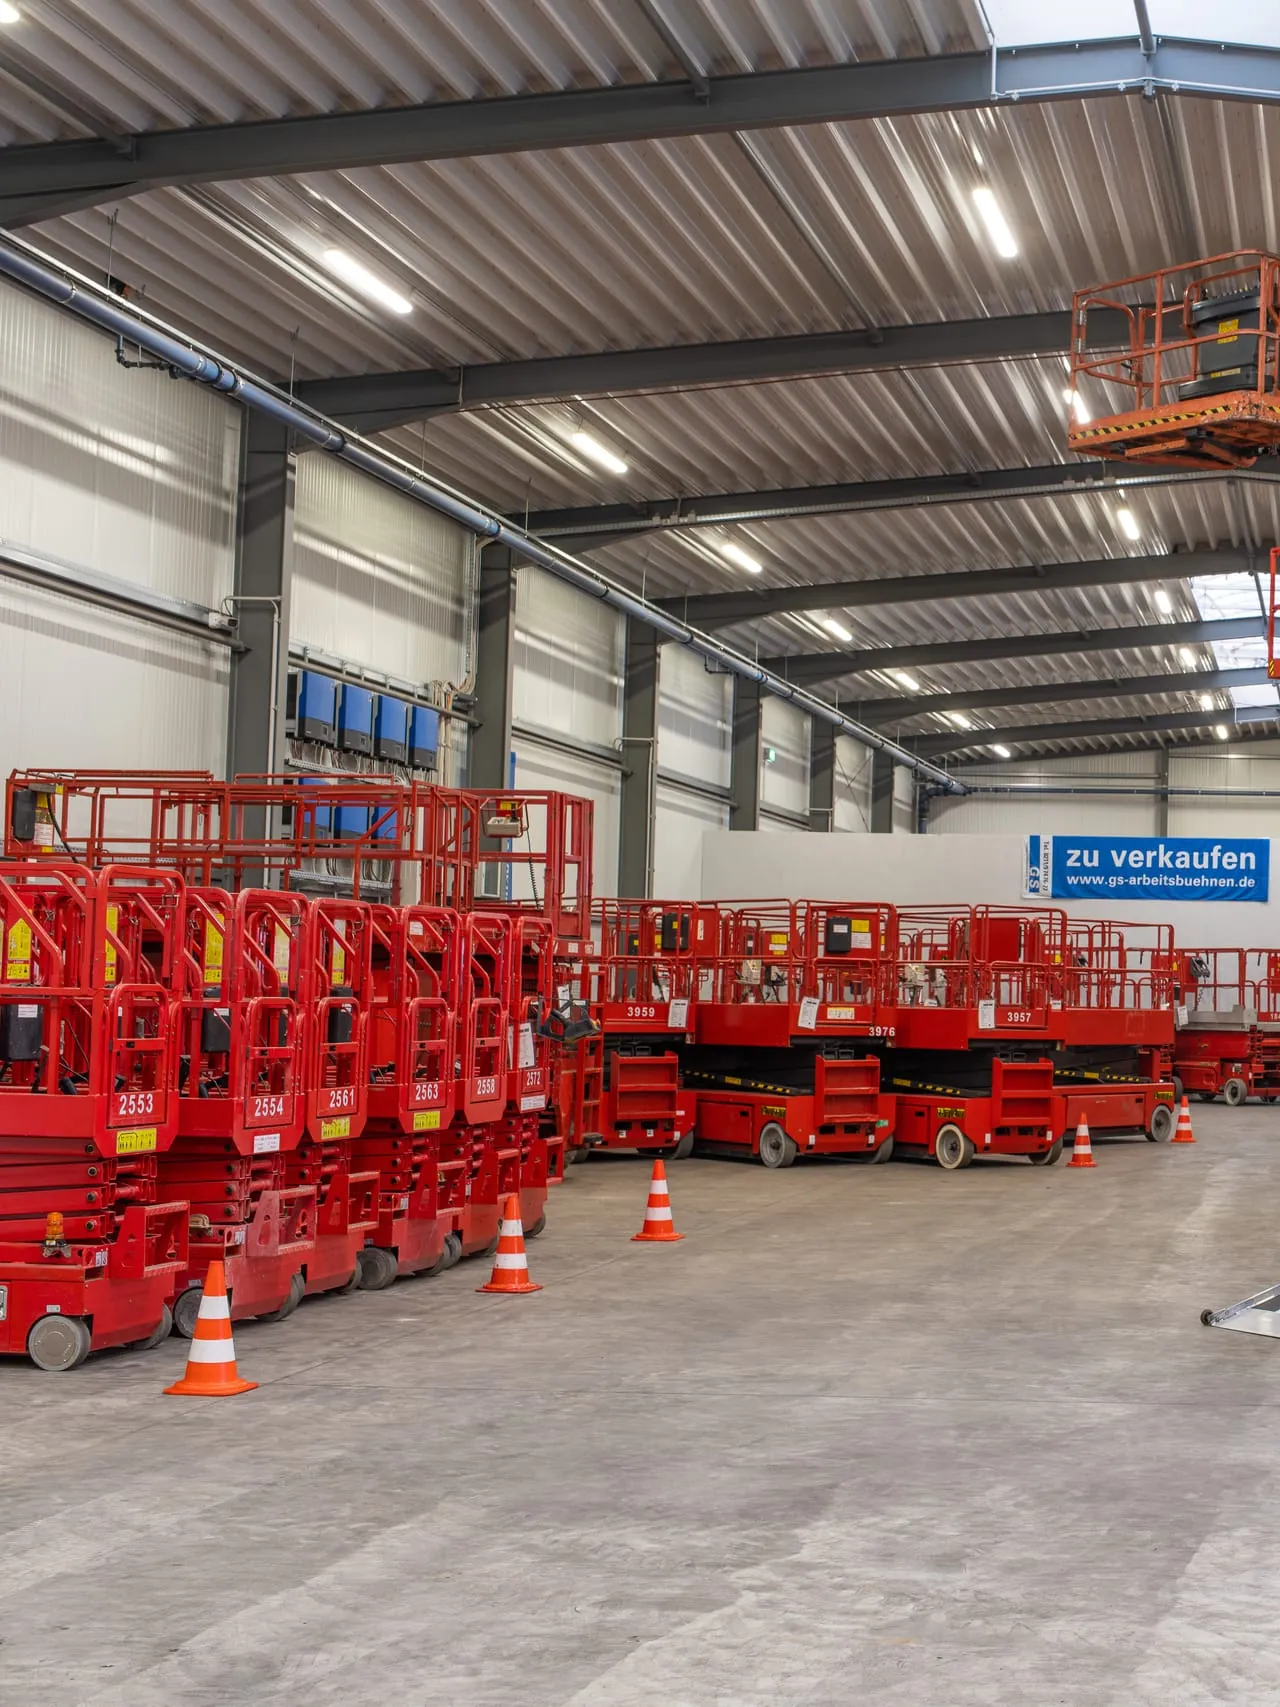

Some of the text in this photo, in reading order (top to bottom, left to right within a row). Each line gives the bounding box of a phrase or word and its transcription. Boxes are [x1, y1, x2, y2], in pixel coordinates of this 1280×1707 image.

[1066, 844, 1256, 870] zu verkaufen
[1067, 874, 1256, 888] www.gs-arbeitsbuehnen.de
[627, 1006, 656, 1017] 3959
[1007, 1012, 1031, 1022] 3957
[868, 1026, 896, 1036] 3976
[477, 1078, 495, 1095] 2558
[526, 1071, 540, 1086] 2572
[329, 1088, 355, 1108] 2561
[415, 1083, 438, 1101] 2563
[119, 1093, 154, 1115] 2553
[254, 1096, 284, 1117] 2554
